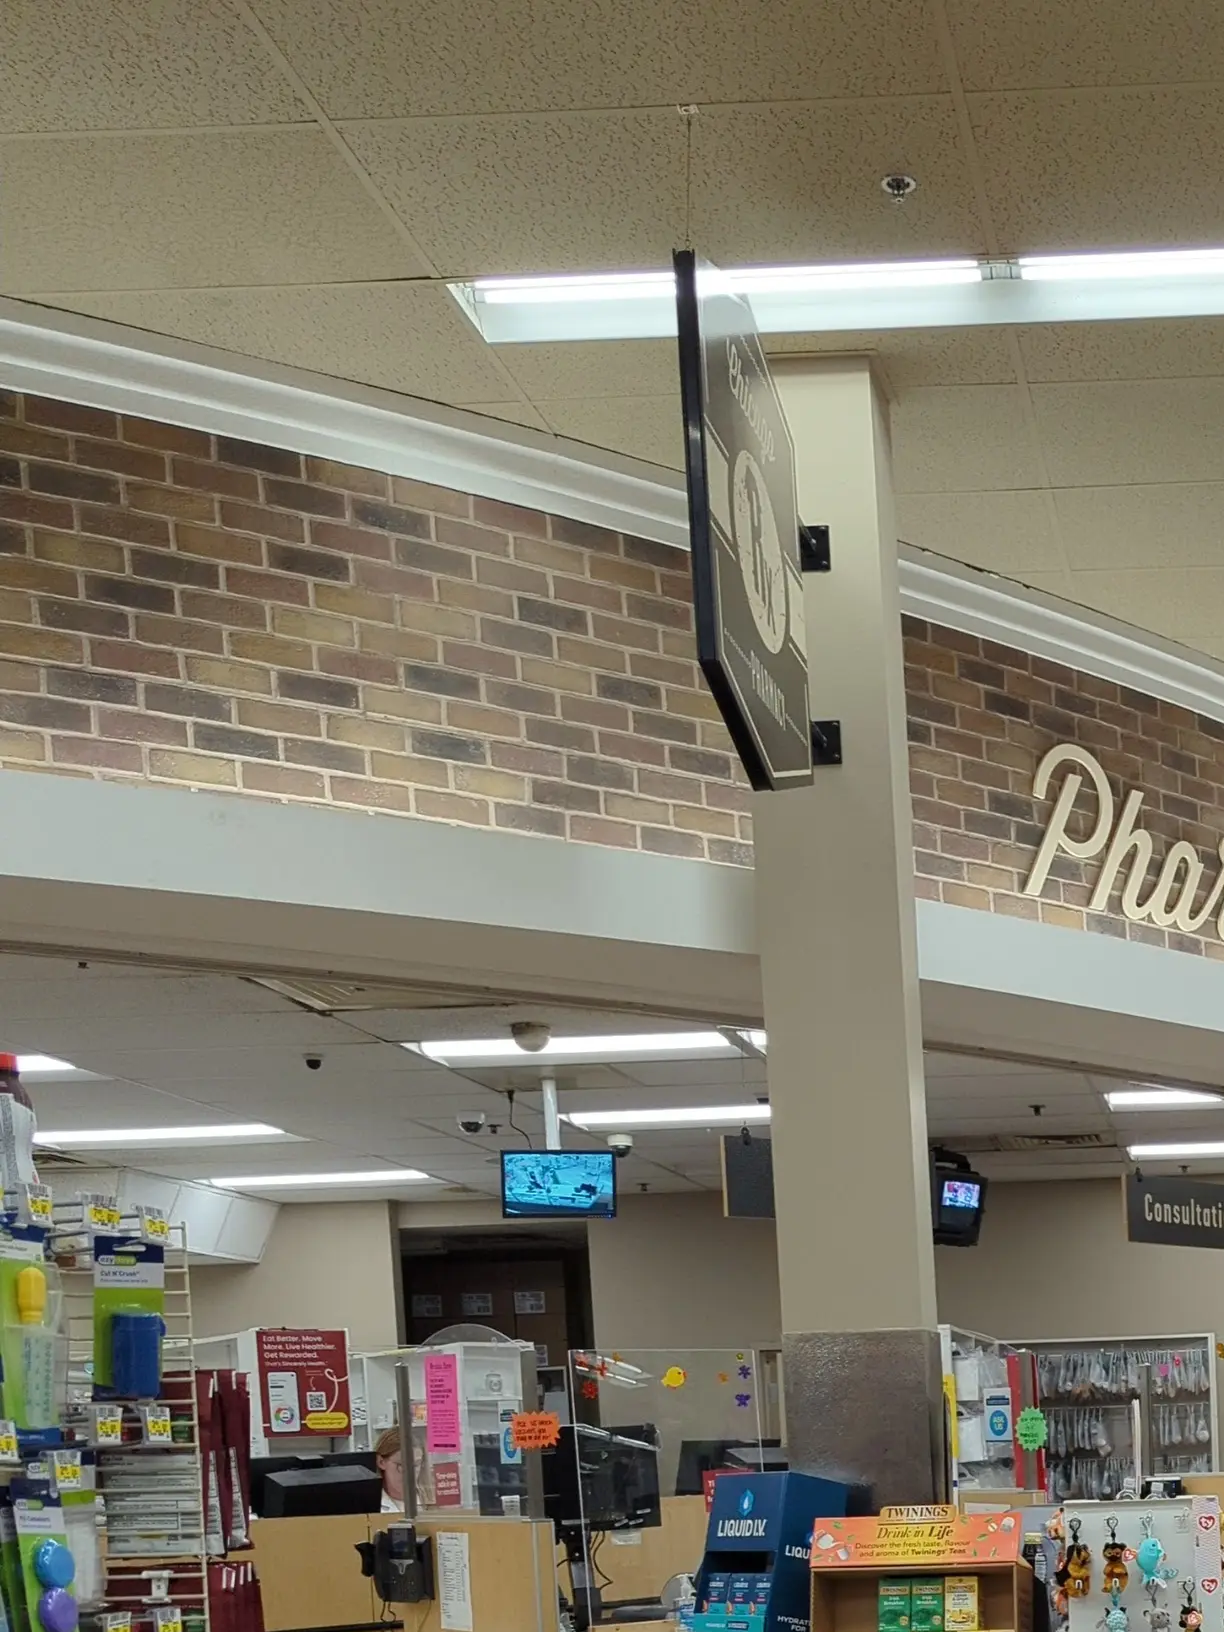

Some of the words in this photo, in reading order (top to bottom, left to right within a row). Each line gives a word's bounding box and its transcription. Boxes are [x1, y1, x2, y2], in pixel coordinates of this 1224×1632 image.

[886, 1505, 950, 1518] TWININGS
[716, 1519, 752, 1537] LIQUID
[877, 1526, 911, 1539] Drink
[913, 1527, 924, 1538] in
[928, 1525, 954, 1538] Life
[855, 1541, 887, 1549] Discover
[889, 1540, 901, 1548] the
[903, 1540, 922, 1548] fresh
[944, 1539, 970, 1547] flavour
[785, 1544, 810, 1560] LIQU
[859, 1549, 874, 1557] and
[900, 1548, 909, 1556] of
[948, 1547, 966, 1556] Teas
[791, 1624, 806, 1632] FOR
